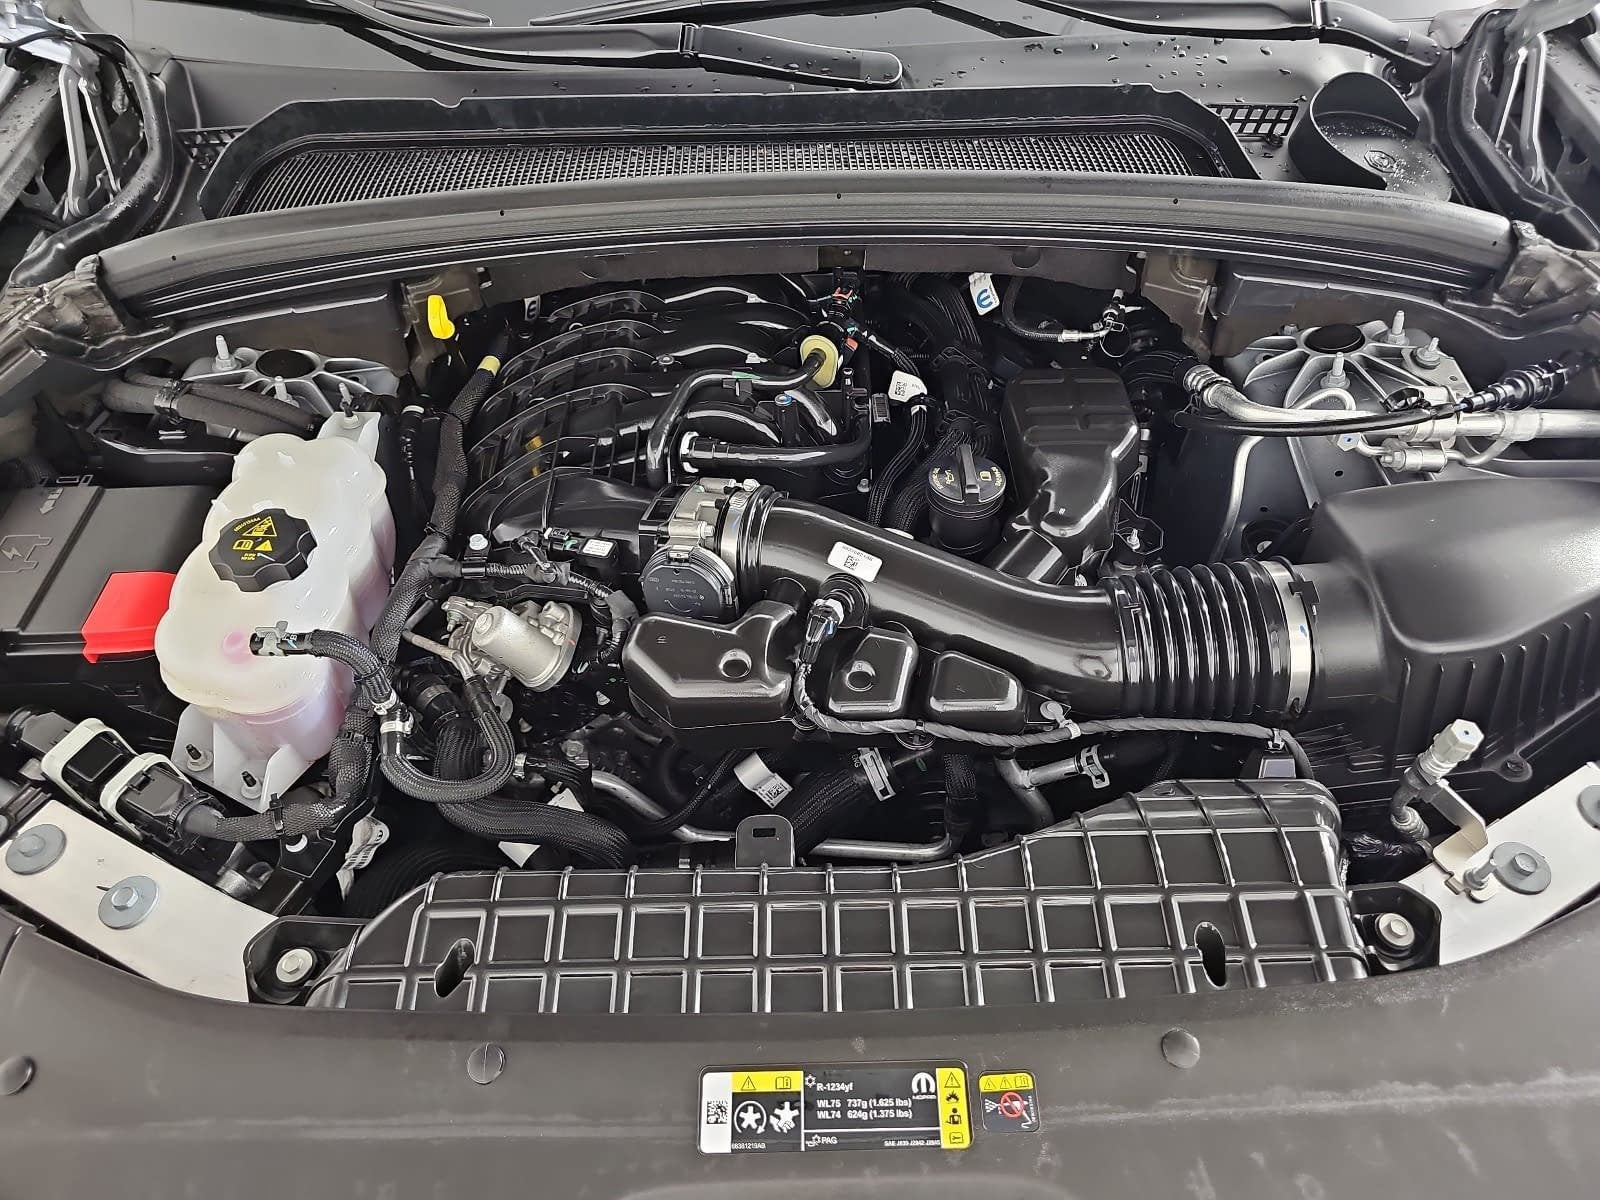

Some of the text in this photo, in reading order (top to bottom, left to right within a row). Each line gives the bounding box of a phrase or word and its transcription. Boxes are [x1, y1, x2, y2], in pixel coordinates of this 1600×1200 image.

[816, 1082, 853, 1092] R-1234yf
[816, 1098, 912, 1109] WL75 737g (1.625 lbs)
[816, 1109, 913, 1120] WL74 624g (1.375 lbs)
[821, 1136, 838, 1145] PAG
